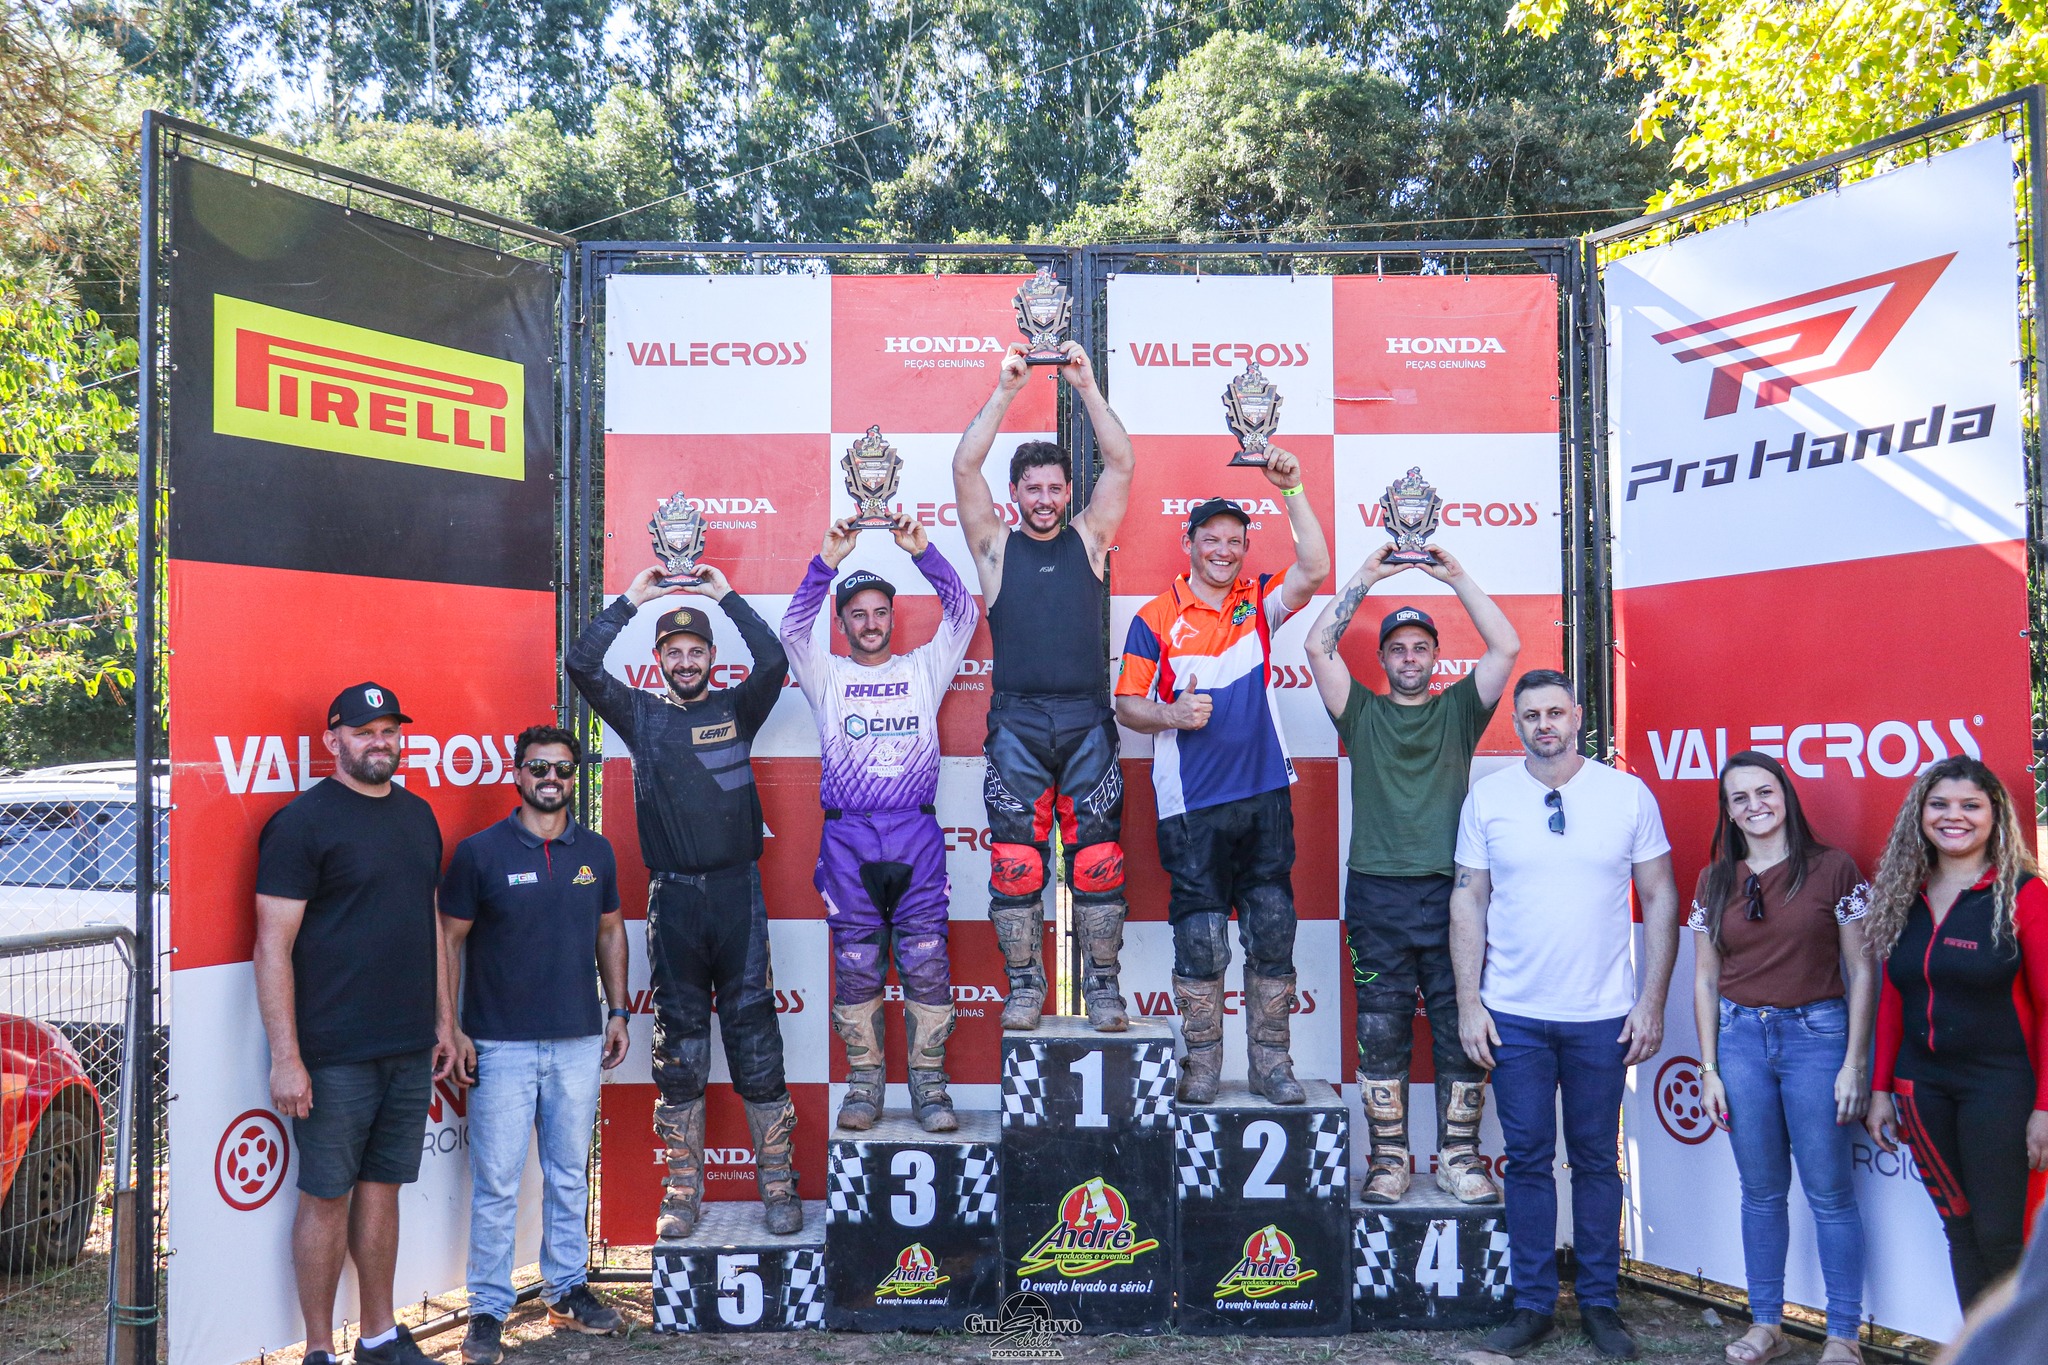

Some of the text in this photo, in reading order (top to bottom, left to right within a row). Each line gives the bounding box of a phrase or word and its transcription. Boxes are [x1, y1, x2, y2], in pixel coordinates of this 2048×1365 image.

[627, 342, 807, 366] VALECROSS
[884, 337, 1005, 353] HONDA
[1129, 342, 1309, 366] VALECROSS
[1386, 338, 1505, 354] HONDA
[904, 357, 985, 370] PEÇAS GENUÍNAS
[1405, 357, 1486, 371] PEÇAS GENUÍNAS
[236, 329, 508, 453] PIRELLI
[709, 519, 757, 530] GENUÍNAS
[1358, 503, 1537, 527] VCROSS
[845, 682, 909, 697] RACER
[947, 681, 984, 691] NUÍNAS
[870, 716, 919, 731] CIVA
[1070, 1050, 1109, 1127] 1
[1242, 1120, 1288, 1198] 2
[706, 1170, 755, 1181] GENUÍNAS
[890, 1150, 936, 1227] 3
[1028, 1219, 1133, 1258] André
[1415, 1219, 1463, 1297] 4
[881, 1265, 935, 1287] André
[1220, 1256, 1299, 1285] André
[717, 1253, 764, 1325] 5
[1020, 1278, 1031, 1292] O
[1033, 1281, 1068, 1294] evento
[1071, 1280, 1107, 1293] levado
[1110, 1283, 1117, 1292] a
[1216, 1298, 1224, 1309] O
[1225, 1300, 1252, 1311] evento
[1253, 1299, 1280, 1309] levado
